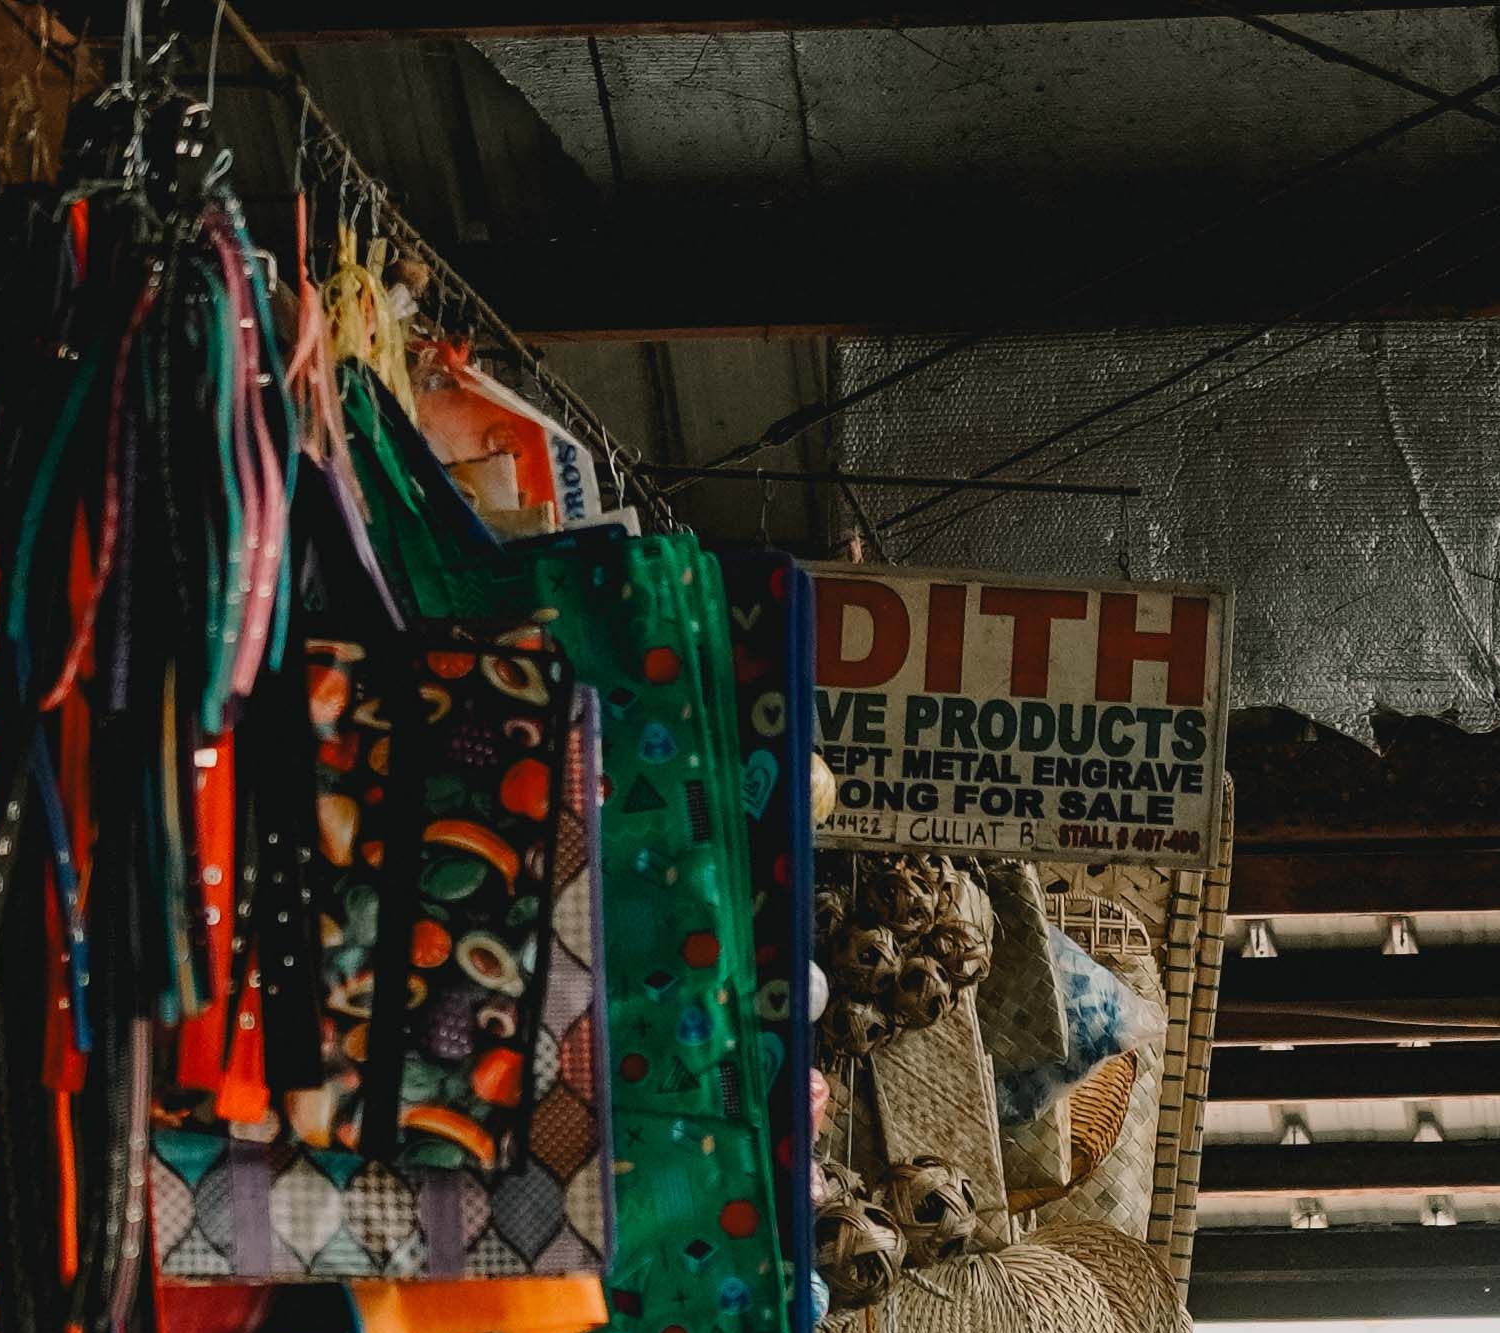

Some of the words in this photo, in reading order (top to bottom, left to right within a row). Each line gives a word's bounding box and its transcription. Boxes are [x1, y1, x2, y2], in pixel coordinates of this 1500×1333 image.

[815, 577, 1209, 705] DITH
[904, 694, 1207, 762] PRODUCTS
[813, 743, 892, 776] EPT
[903, 749, 1021, 783] METAL
[1033, 756, 1203, 794] ENGRAVE
[953, 784, 1044, 818] FOR
[1058, 790, 1174, 825] SALE
[909, 817, 1005, 848] CULIAT
[1058, 824, 1113, 849] STALL
